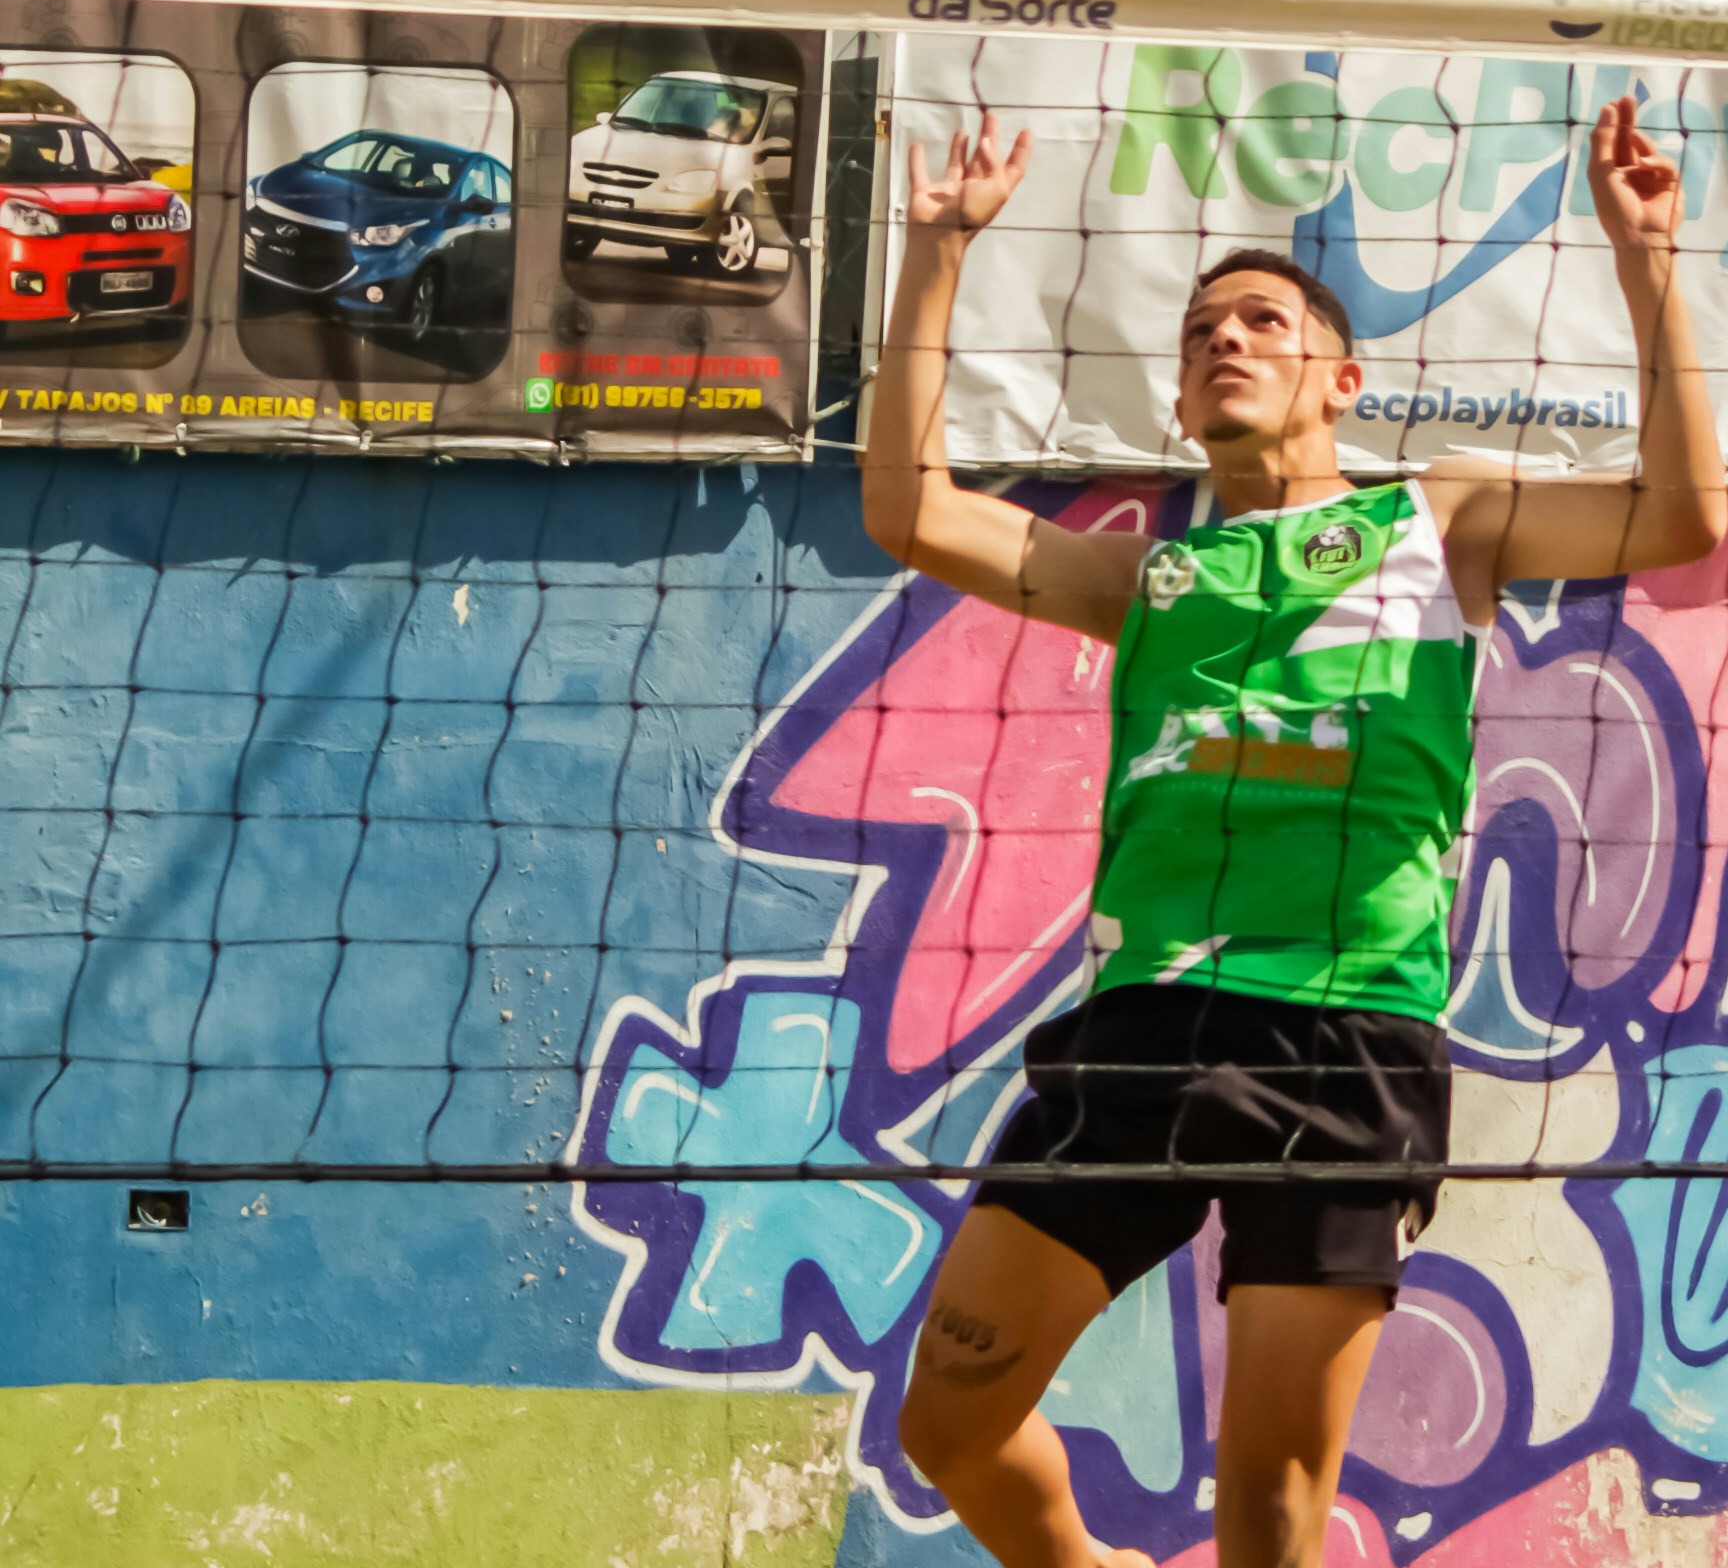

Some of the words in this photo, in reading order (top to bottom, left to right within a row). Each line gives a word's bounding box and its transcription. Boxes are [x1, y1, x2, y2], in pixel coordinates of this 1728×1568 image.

[16, 389, 138, 414] TAPAJOS
[180, 394, 213, 416] 89
[219, 396, 316, 420] AREIAS
[339, 399, 433, 423] RECIFE
[1355, 385, 1627, 431] ecplaybrasil
